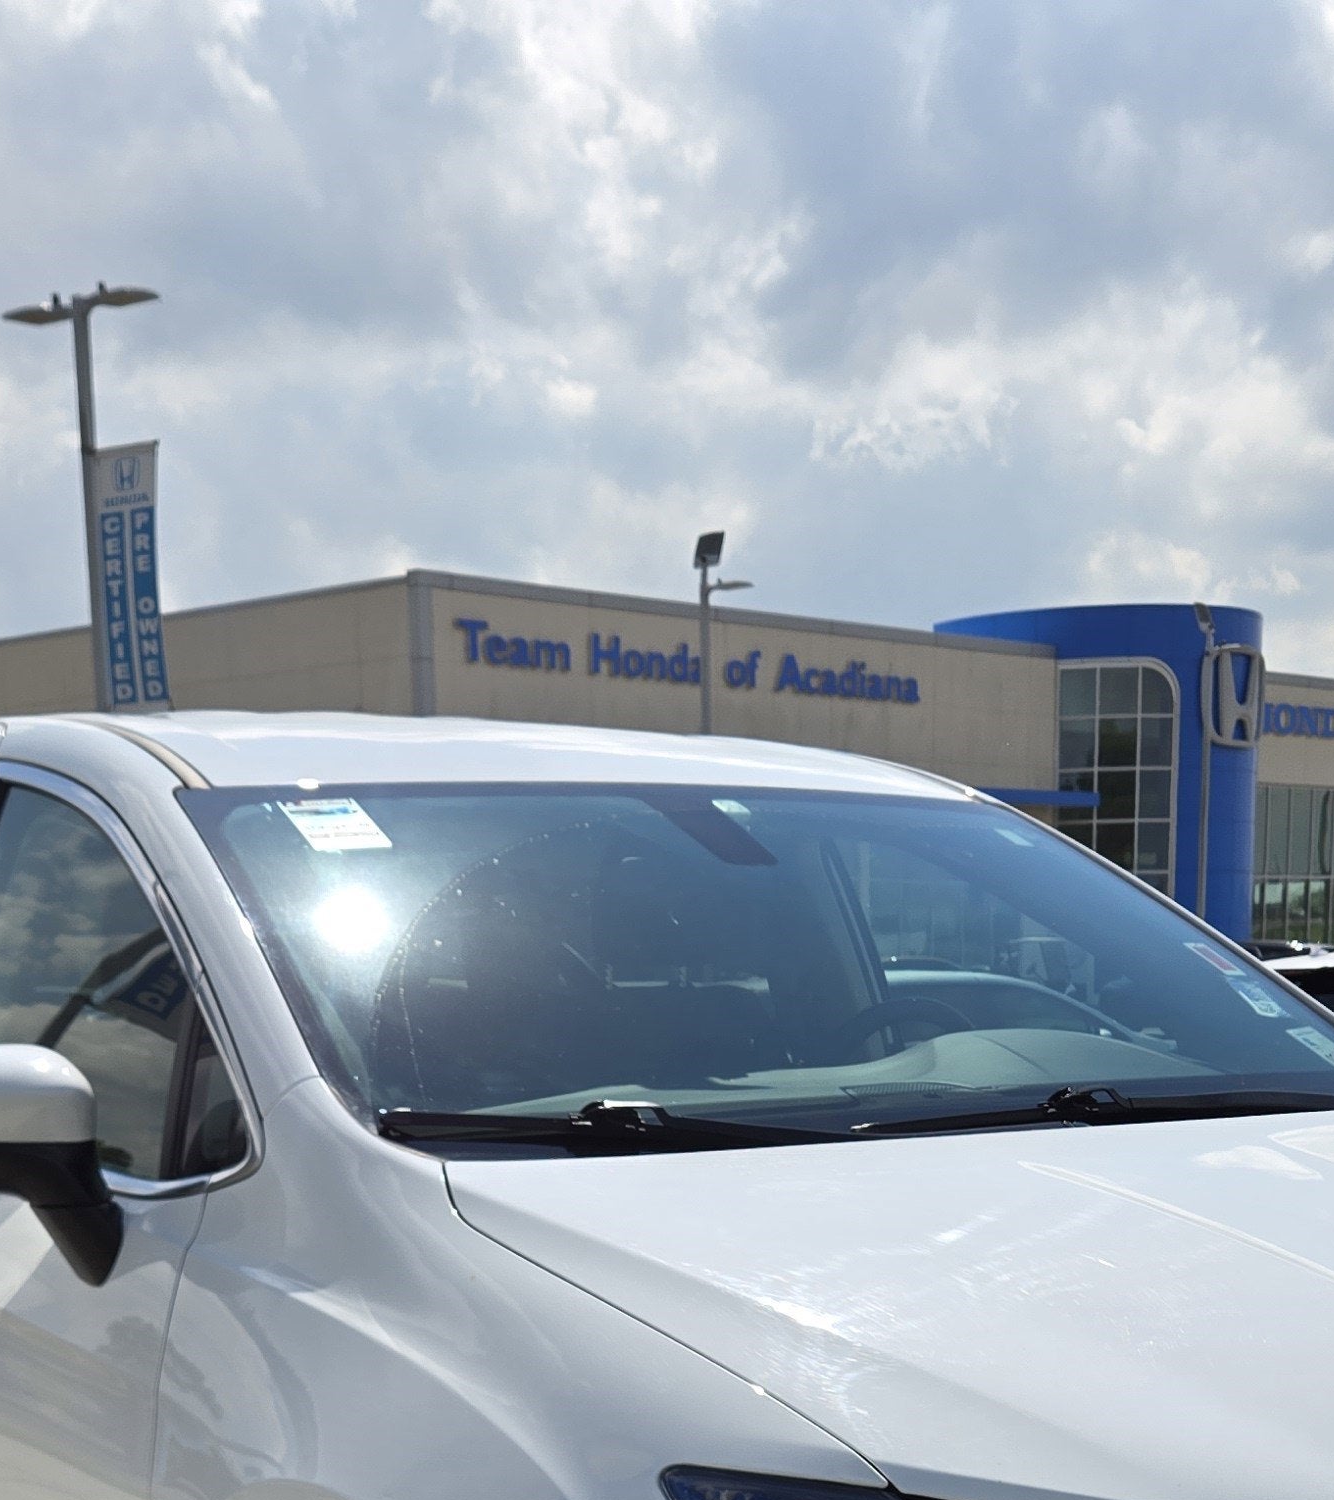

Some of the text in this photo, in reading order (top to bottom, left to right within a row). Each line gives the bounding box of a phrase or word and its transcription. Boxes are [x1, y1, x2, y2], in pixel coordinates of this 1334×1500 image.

[102, 515, 134, 701] CERTIFIED
[134, 511, 164, 699] PRE OWNED
[454, 617, 571, 672] Team
[725, 650, 762, 689] of
[773, 652, 921, 704] Acadiana
